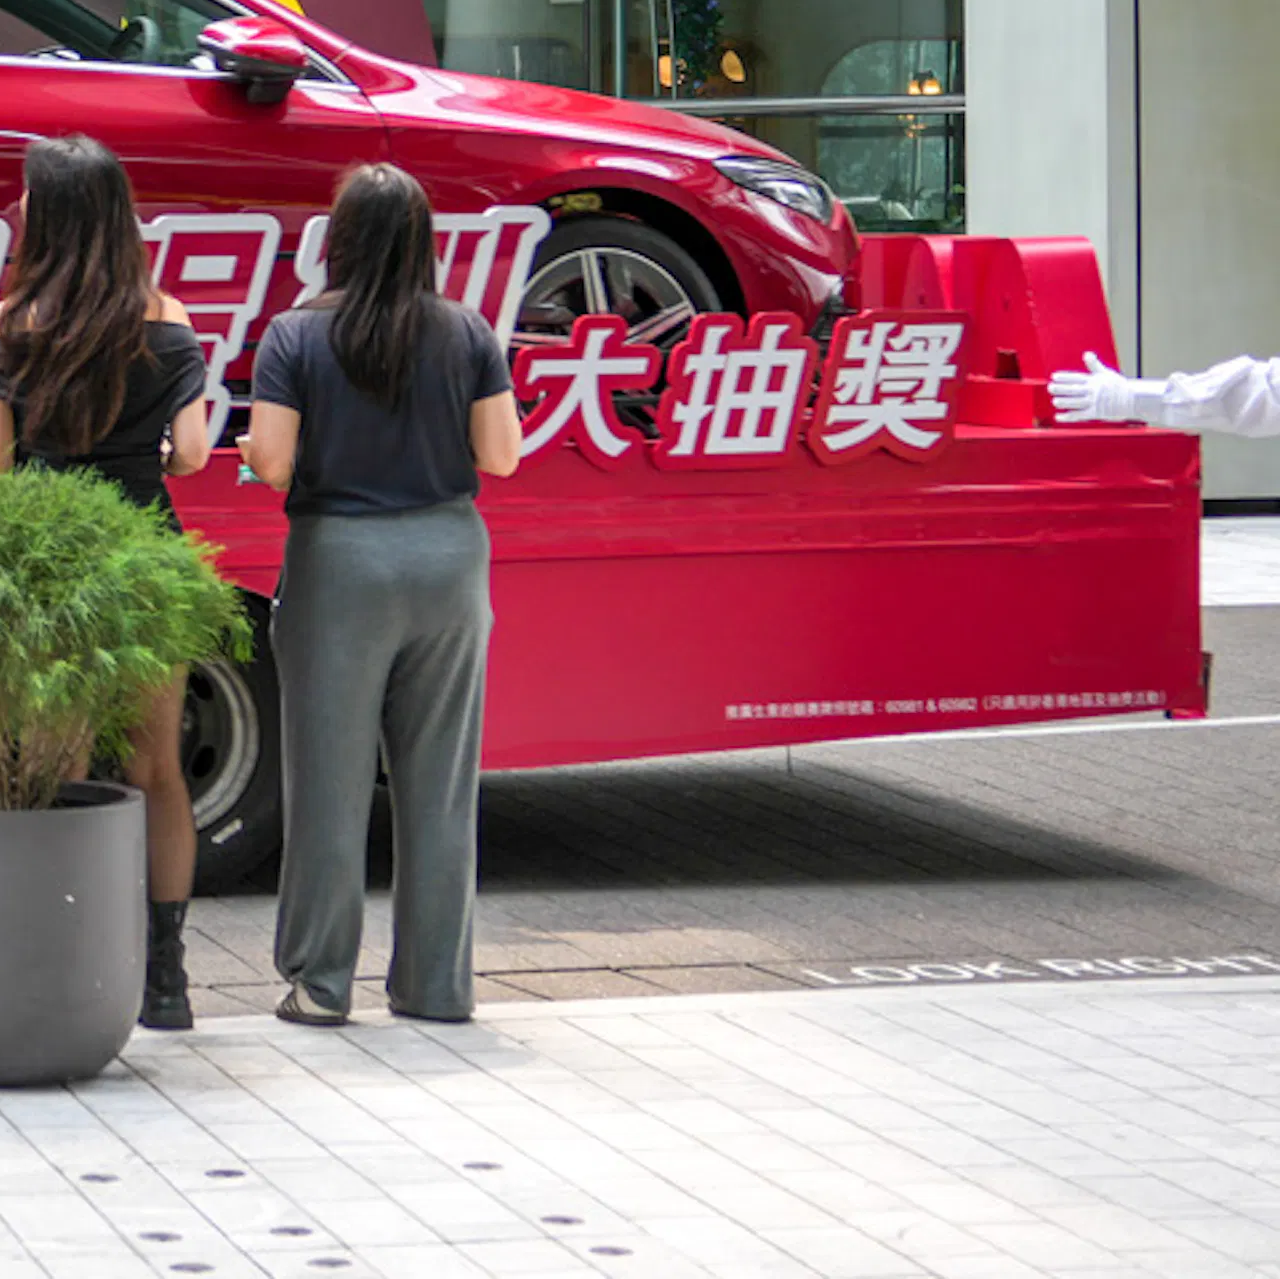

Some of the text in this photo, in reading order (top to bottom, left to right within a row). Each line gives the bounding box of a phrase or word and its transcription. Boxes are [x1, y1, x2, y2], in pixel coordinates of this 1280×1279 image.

[520, 320, 964, 459] 大抽獎
[801, 956, 1280, 985] LOOK RIGHT
